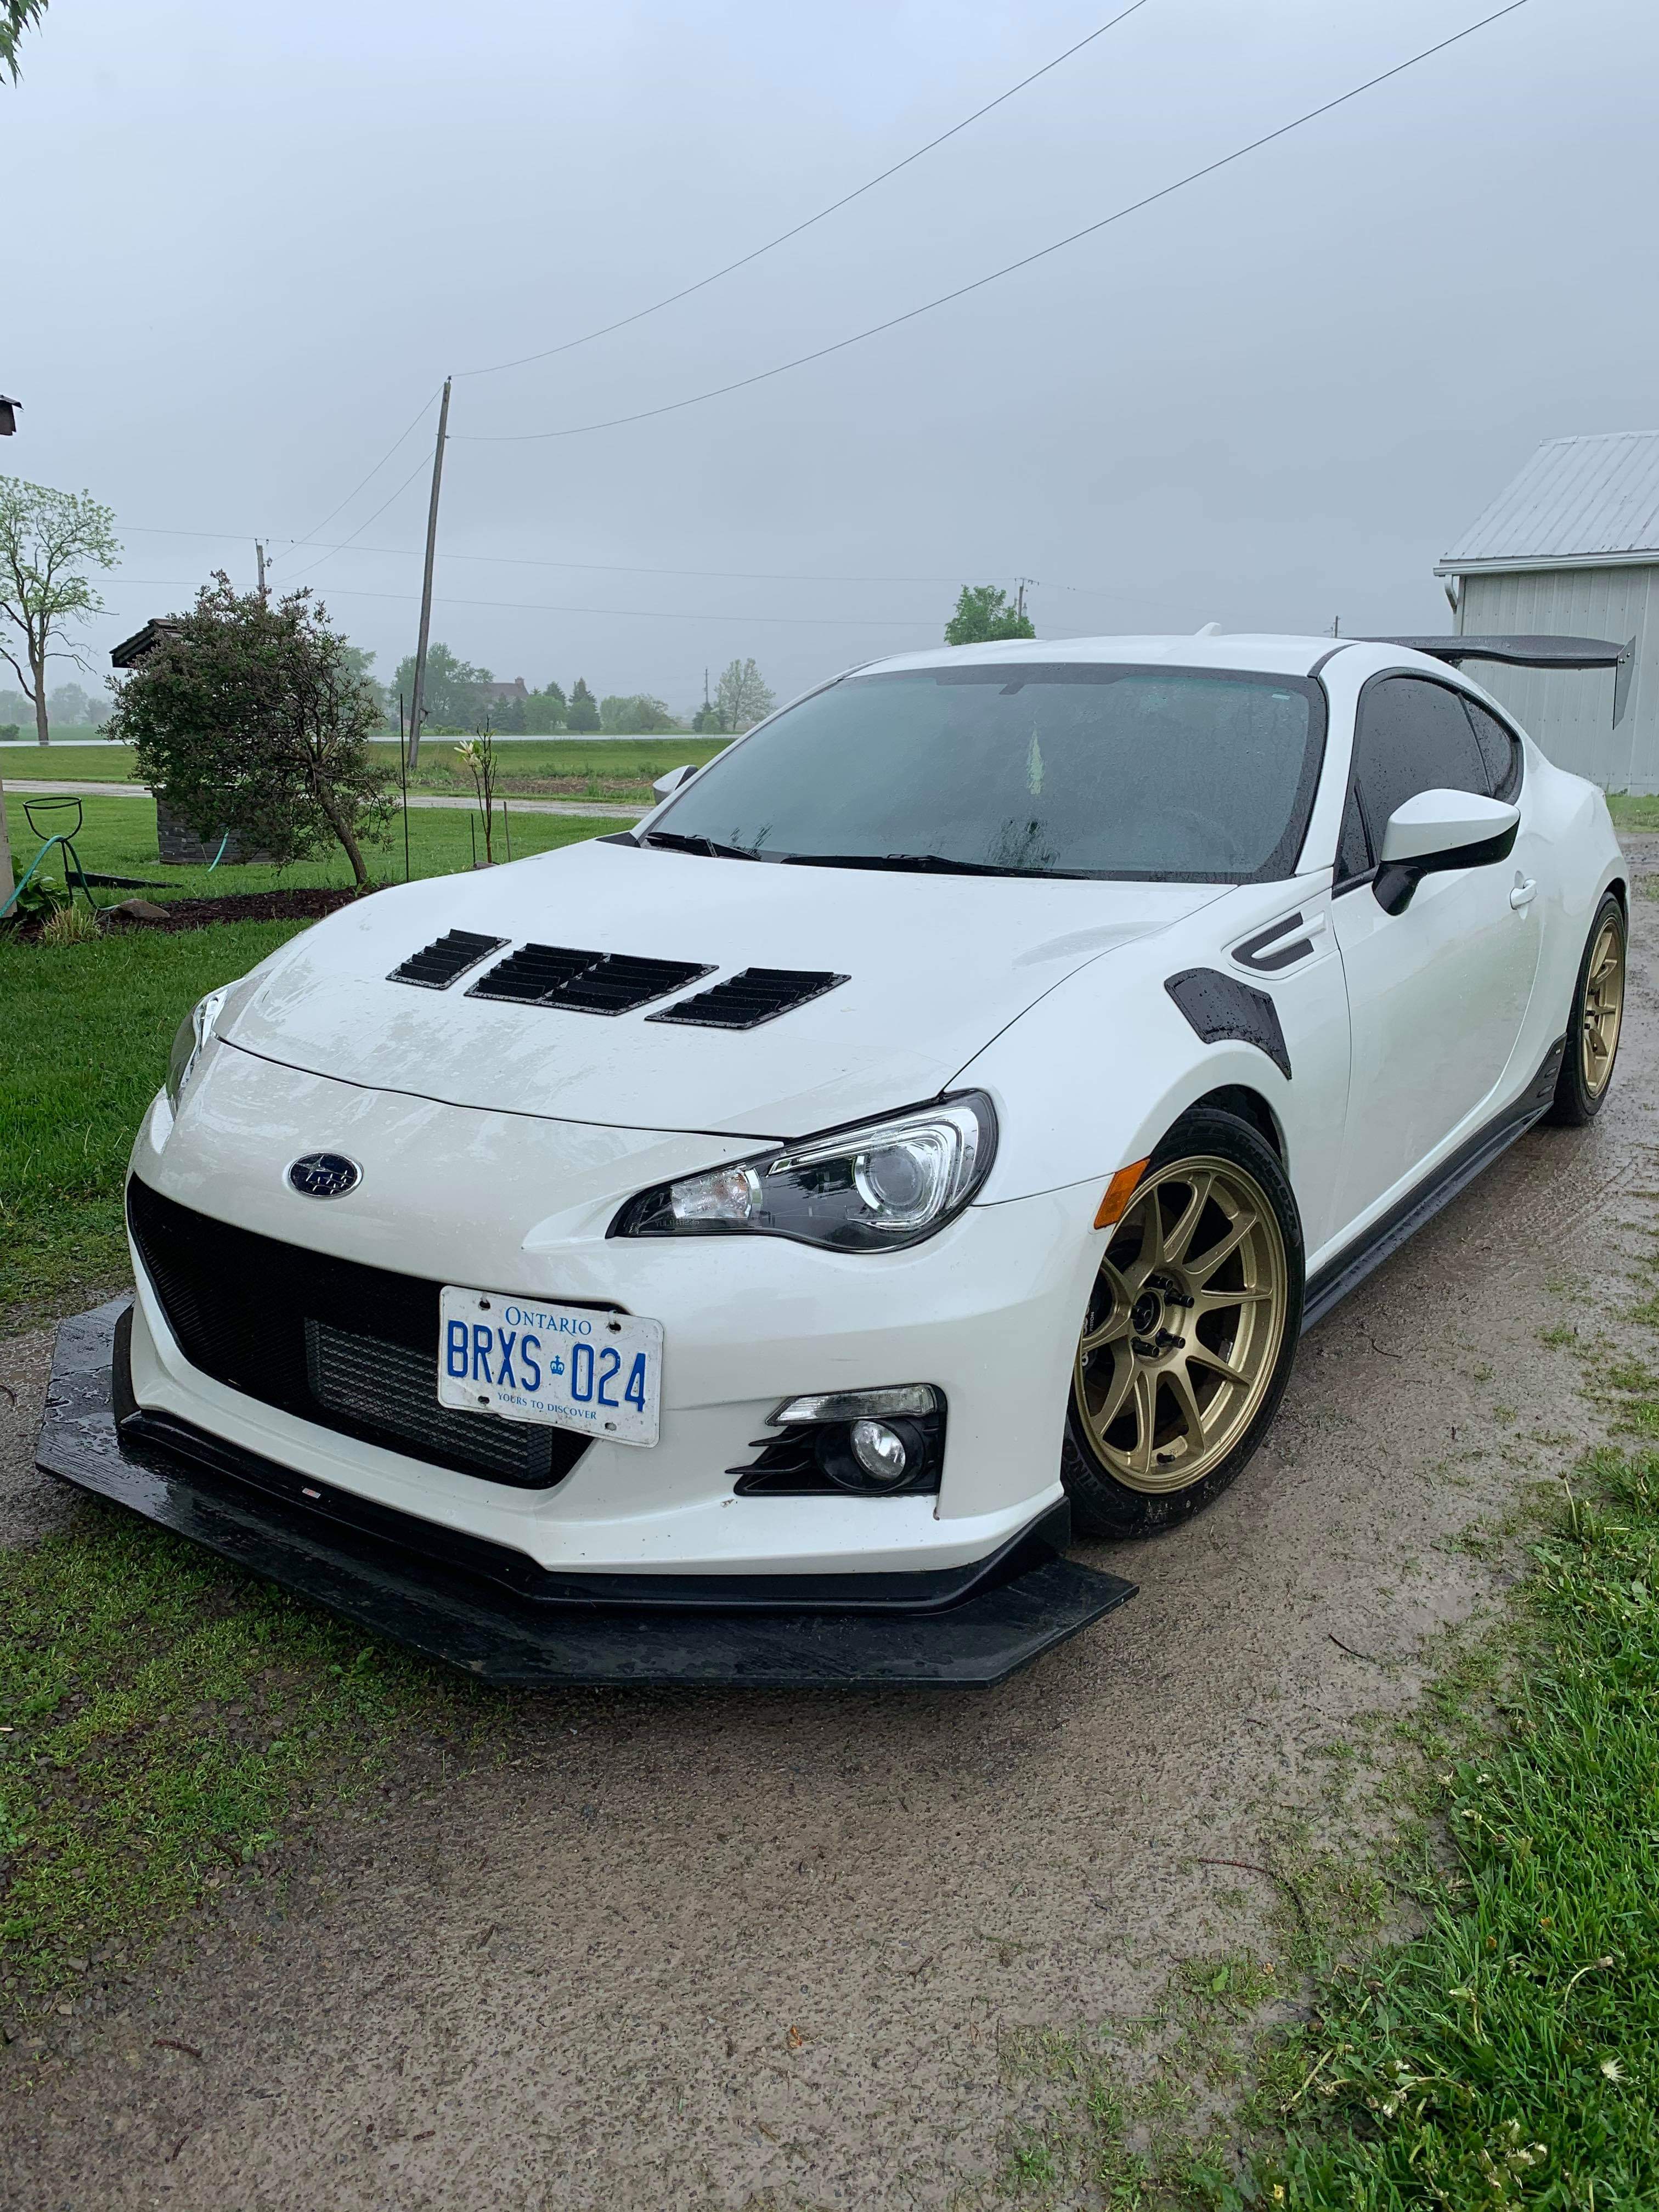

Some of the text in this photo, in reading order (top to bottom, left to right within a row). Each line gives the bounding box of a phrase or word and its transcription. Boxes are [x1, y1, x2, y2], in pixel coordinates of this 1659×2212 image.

[505, 1306, 592, 1336] ONTARIO
[447, 1319, 646, 1413] BRXS 024
[497, 1392, 597, 1420] YOURS TO DISCOVER
